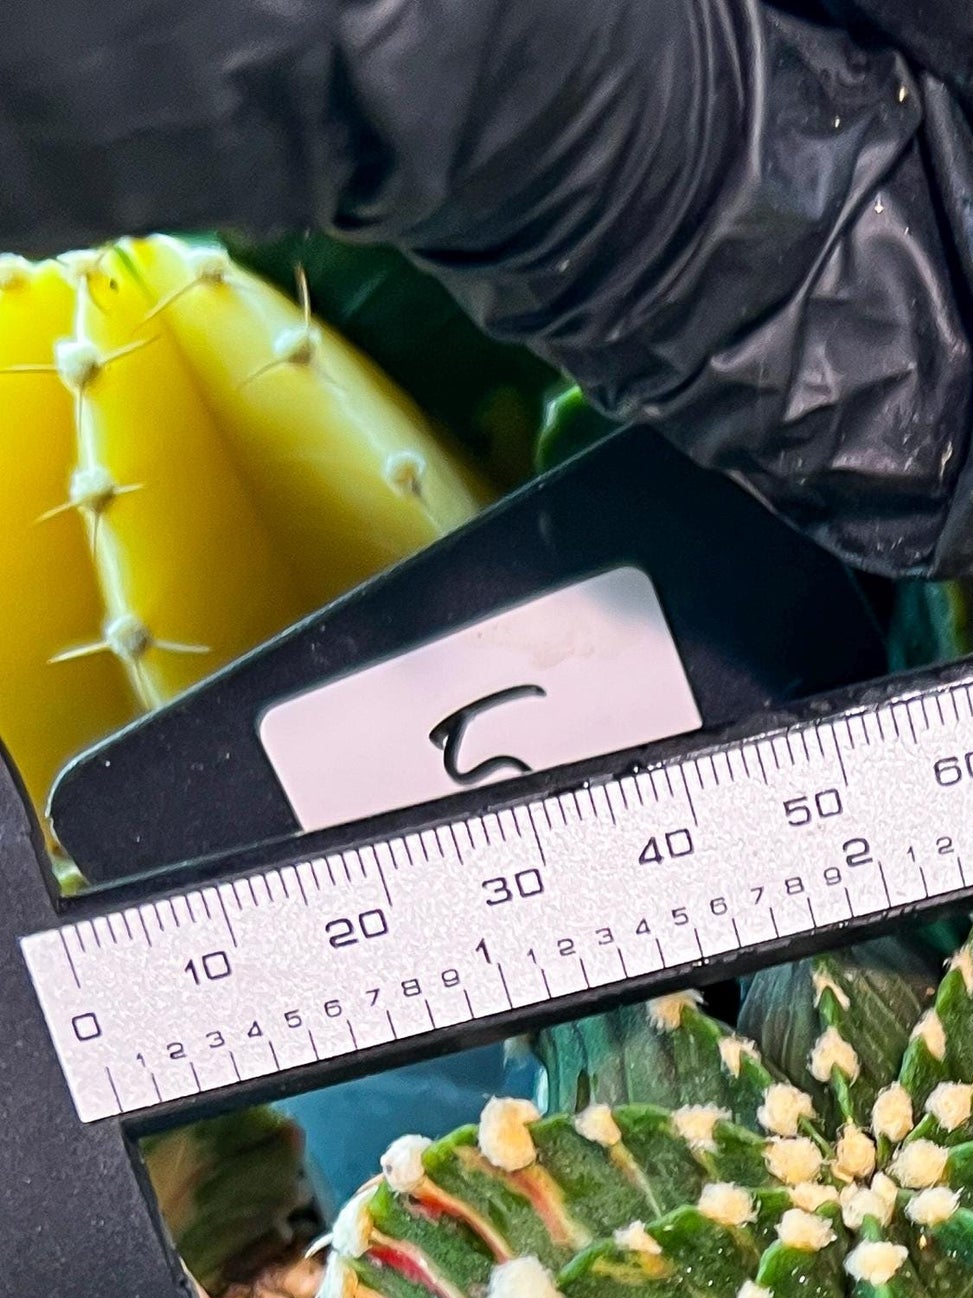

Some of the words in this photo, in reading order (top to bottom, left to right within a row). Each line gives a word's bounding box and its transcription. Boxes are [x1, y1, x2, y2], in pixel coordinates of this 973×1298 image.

[71, 1011, 103, 1042] 0
[184, 950, 233, 986] 10
[324, 908, 389, 950] 20
[481, 867, 545, 907] 30
[638, 827, 695, 866] 40
[782, 787, 844, 828] 50
[136, 1052, 146, 1068] 1
[166, 1041, 188, 1060] 2
[205, 1030, 226, 1049] 3
[246, 1020, 264, 1039] 4
[283, 1008, 303, 1029] 5
[323, 999, 343, 1019] 6
[365, 987, 381, 1007] 7
[400, 977, 423, 998] 8
[440, 968, 461, 989] 9
[474, 937, 492, 965] 1
[526, 948, 537, 965] 1
[556, 937, 577, 957] 2
[594, 926, 615, 946] 3
[635, 917, 652, 936] 4
[670, 906, 690, 927] 5
[709, 896, 728, 916] 6
[750, 886, 765, 905] 7
[784, 876, 805, 896] 8
[823, 866, 843, 887] 9
[841, 837, 874, 868] 2
[906, 845, 916, 863] 1
[935, 836, 955, 856] 2
